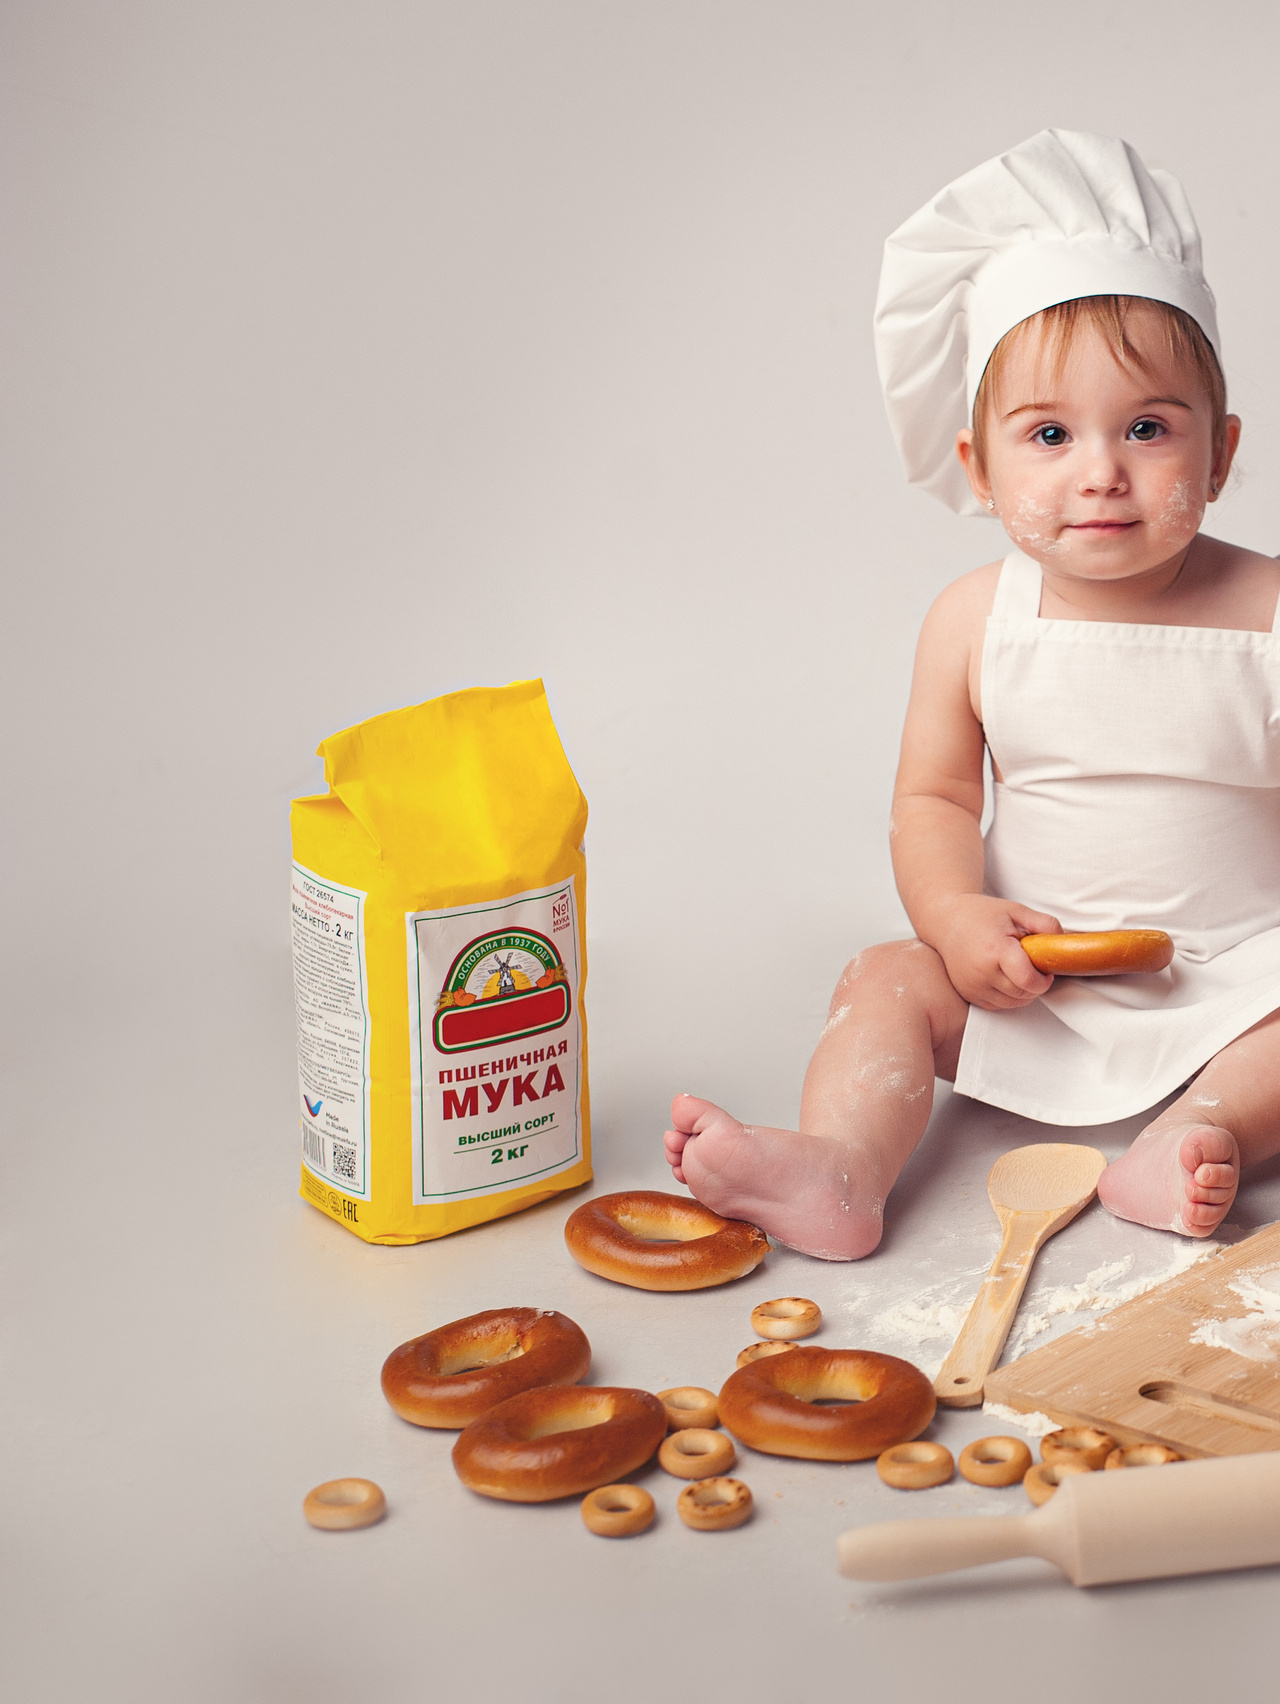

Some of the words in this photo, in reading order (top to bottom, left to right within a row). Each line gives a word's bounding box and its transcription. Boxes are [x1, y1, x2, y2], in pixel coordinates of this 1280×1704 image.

[292, 902, 309, 923] МАССА
[309, 915, 330, 933] НЕТТО
[335, 923, 342, 938] 2
[552, 914, 570, 928] МУКА
[458, 940, 499, 980] ОСНОВАНА
[501, 938, 507, 946] В
[510, 937, 531, 948] 1937
[531, 943, 551, 962] ГОДУ
[438, 1039, 568, 1085] ПШЕНИЧНАЯ
[442, 1063, 566, 1121] МУКА
[331, 1122, 350, 1134] Russia
[458, 1121, 521, 1146] ВЫСШИЙ
[524, 1112, 555, 1130] СОРТ
[490, 1148, 504, 1165] 2
